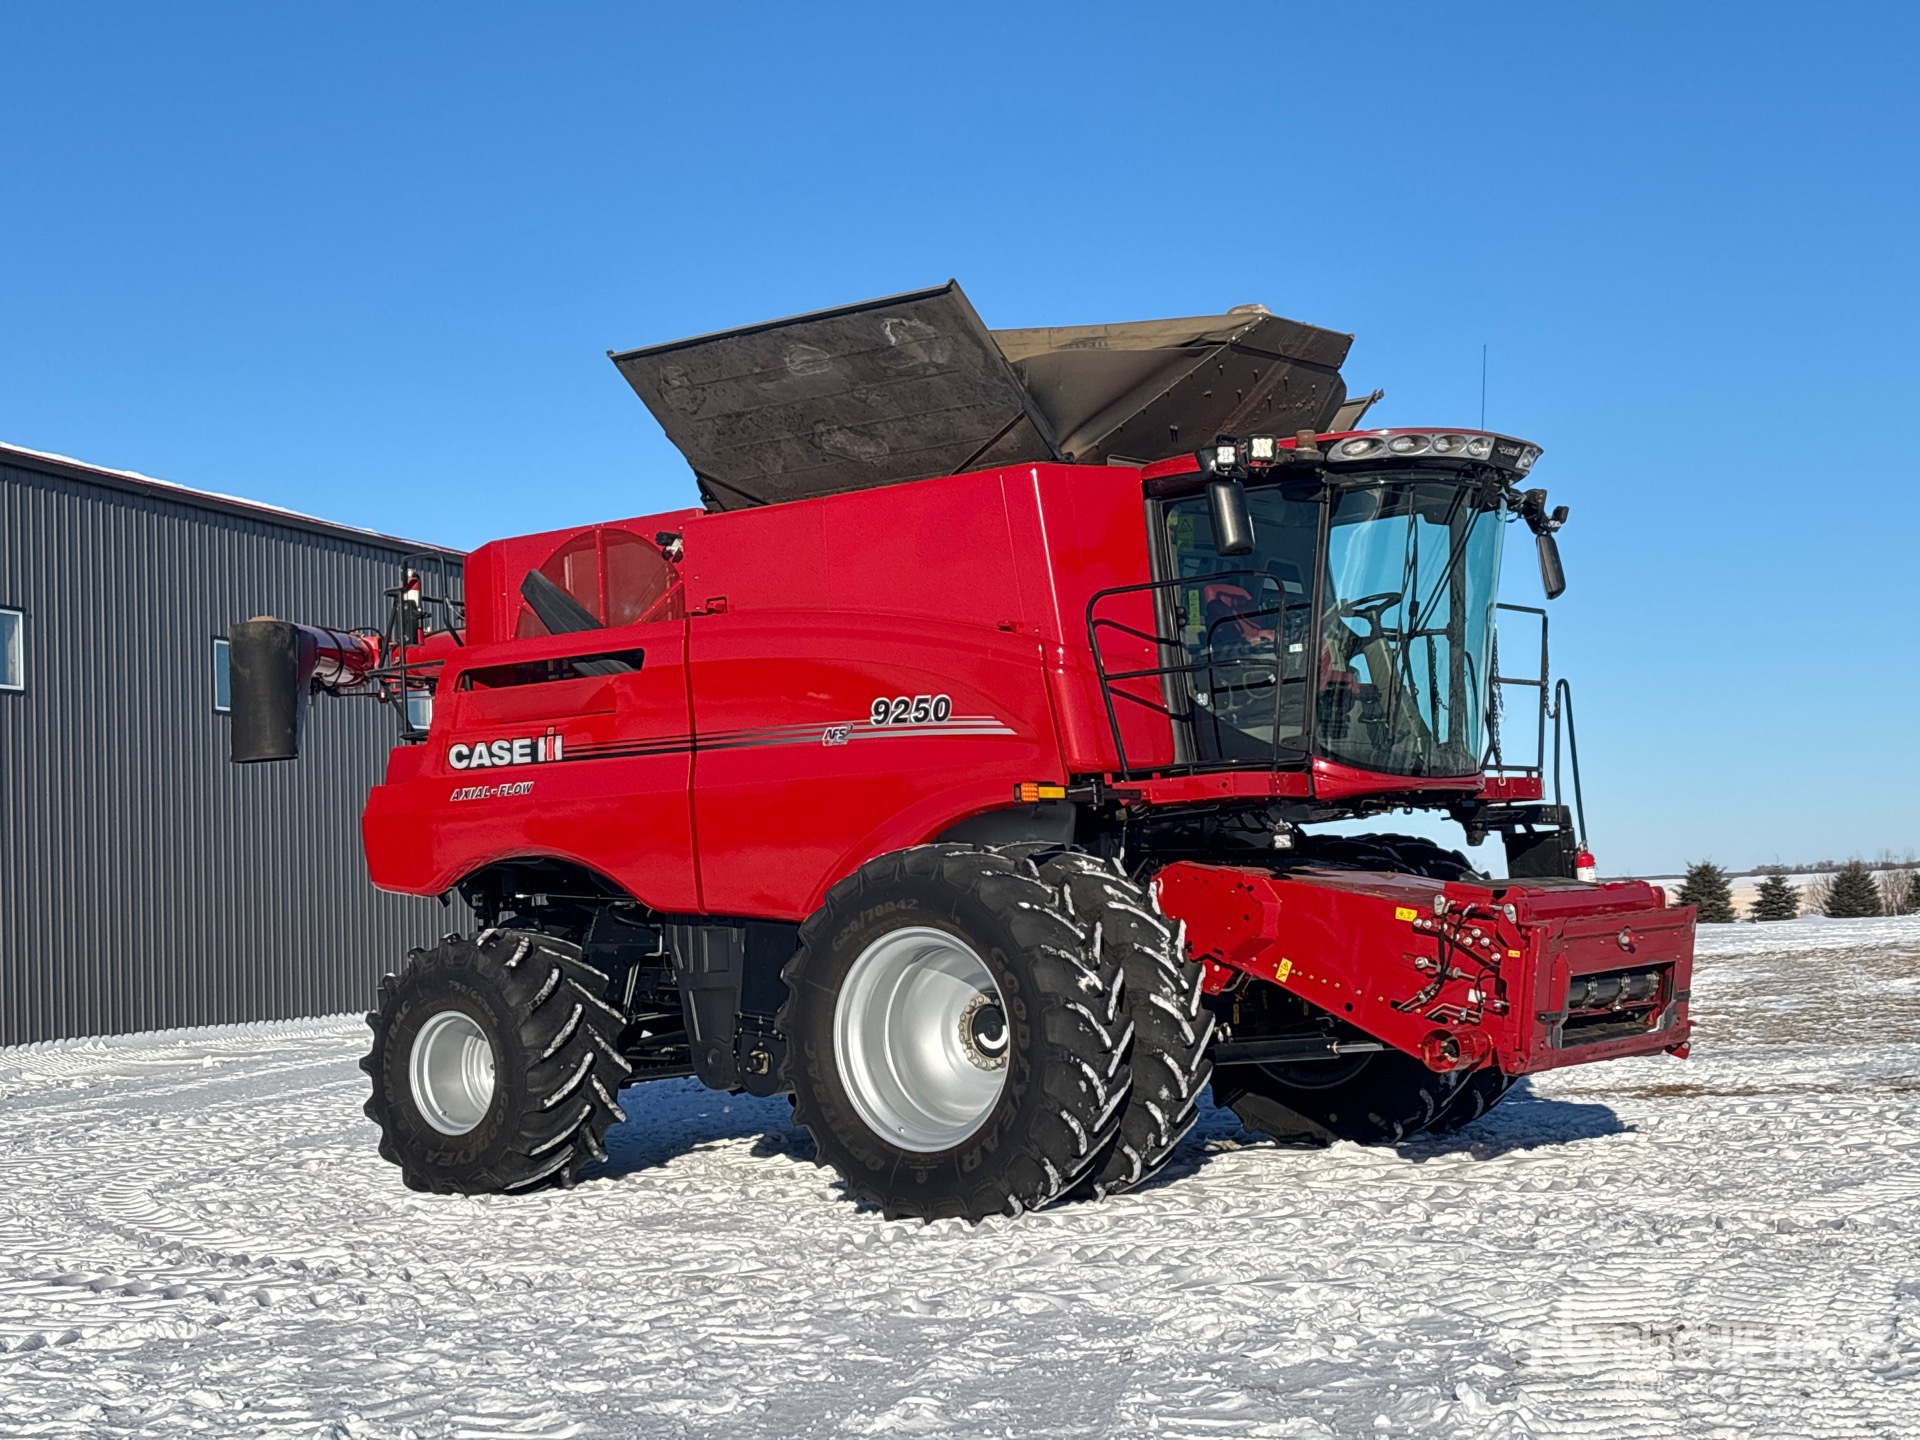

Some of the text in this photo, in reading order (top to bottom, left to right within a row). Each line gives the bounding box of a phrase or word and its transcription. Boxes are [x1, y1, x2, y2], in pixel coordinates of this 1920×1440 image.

[871, 695, 952, 726] 9250
[823, 727, 850, 741] AFS
[449, 738, 532, 769] CASE
[451, 781, 534, 801] AXIAL-FLOW
